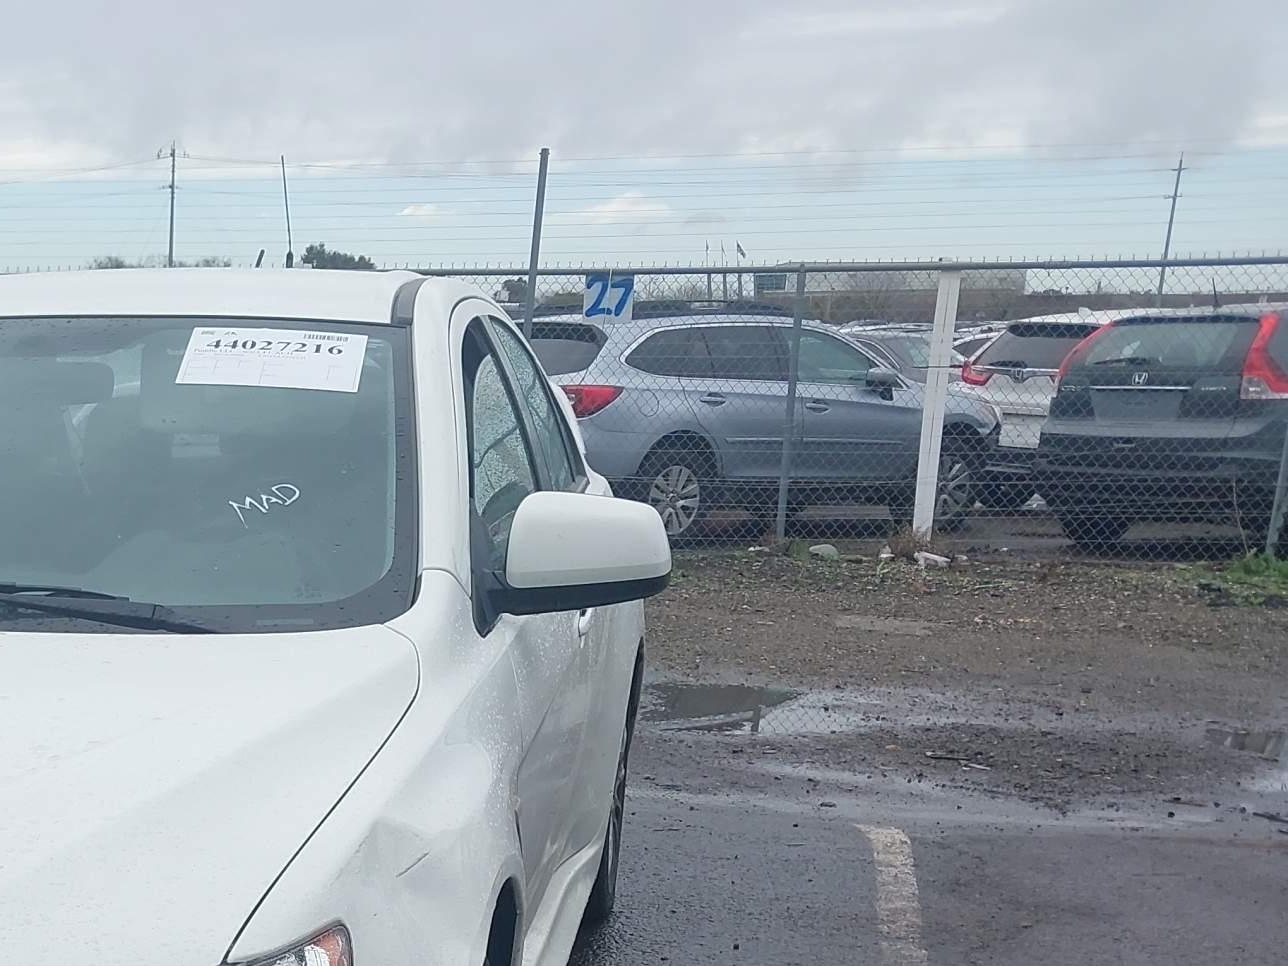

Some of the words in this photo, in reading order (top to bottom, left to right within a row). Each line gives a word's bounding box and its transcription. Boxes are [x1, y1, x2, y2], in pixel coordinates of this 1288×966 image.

[585, 272, 633, 317] 27
[206, 338, 344, 356] 44027216
[228, 483, 300, 528] MAD
